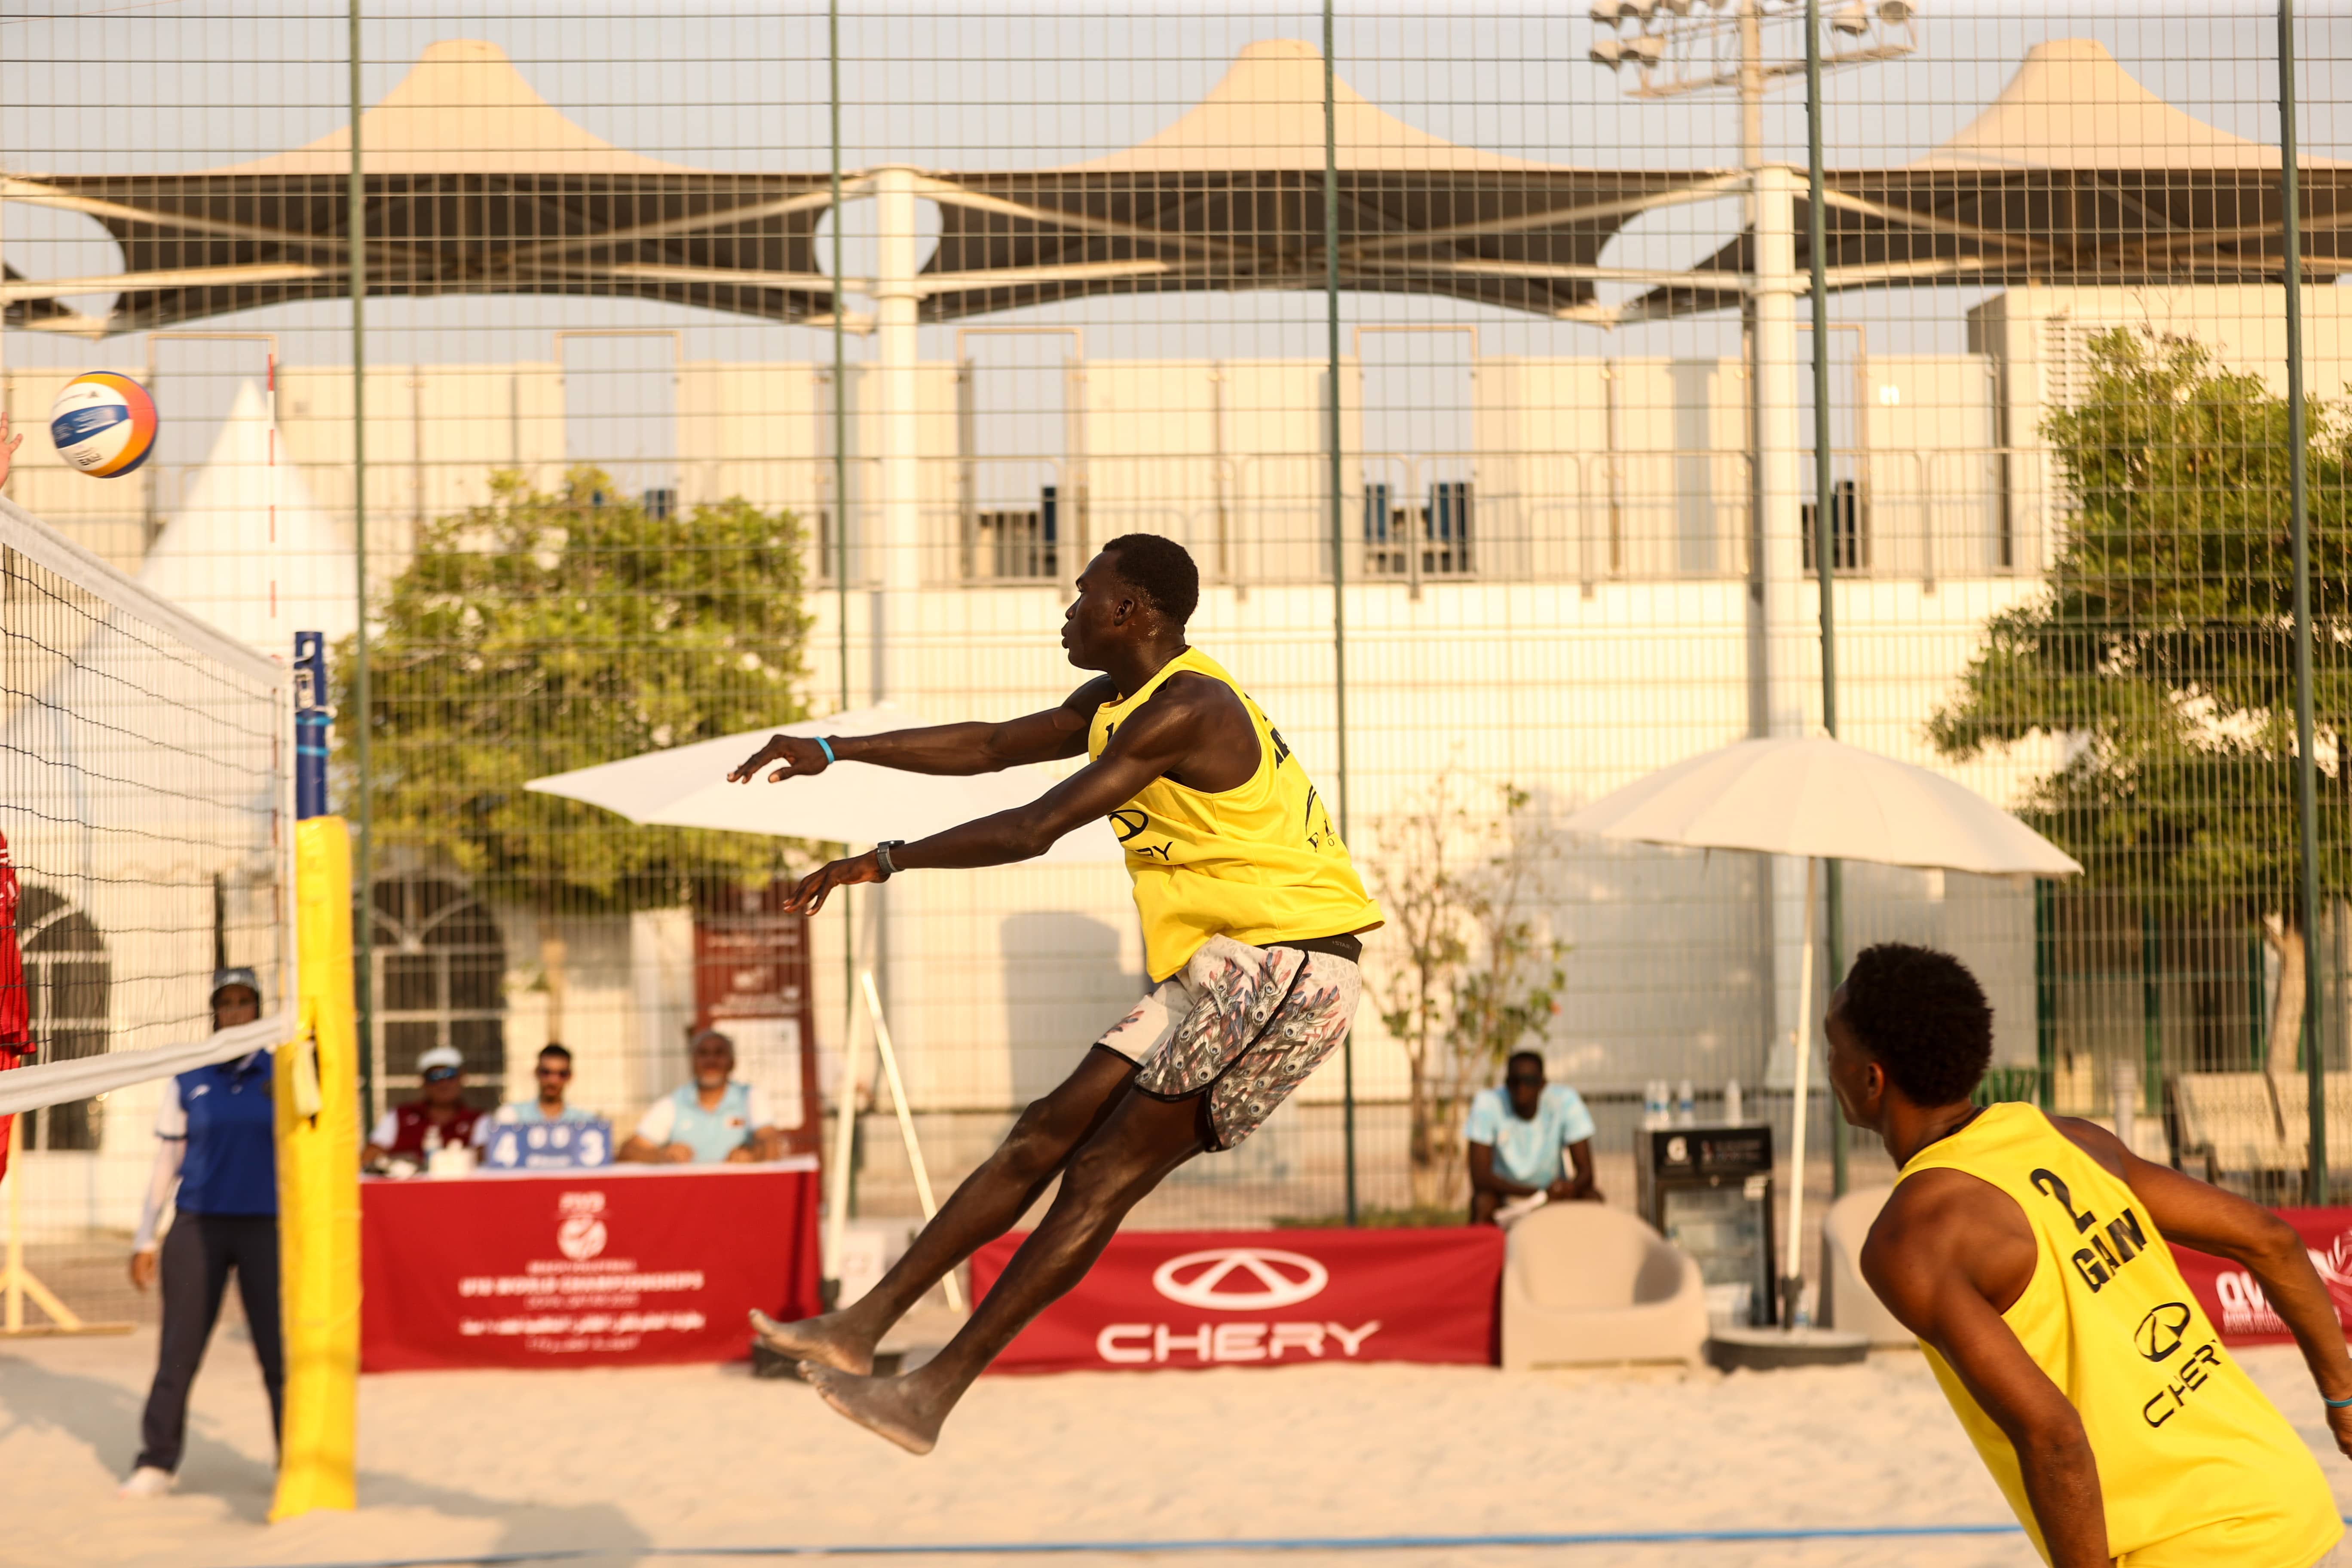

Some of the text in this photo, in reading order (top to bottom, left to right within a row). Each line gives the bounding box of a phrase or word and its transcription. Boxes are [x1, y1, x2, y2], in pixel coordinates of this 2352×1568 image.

[493, 1131, 519, 1169] 4
[580, 1129, 605, 1167] 3
[2030, 1168, 2097, 1234] 2
[1096, 1320, 1381, 1363] CHERY
[2143, 1339, 2221, 1428] CHER
